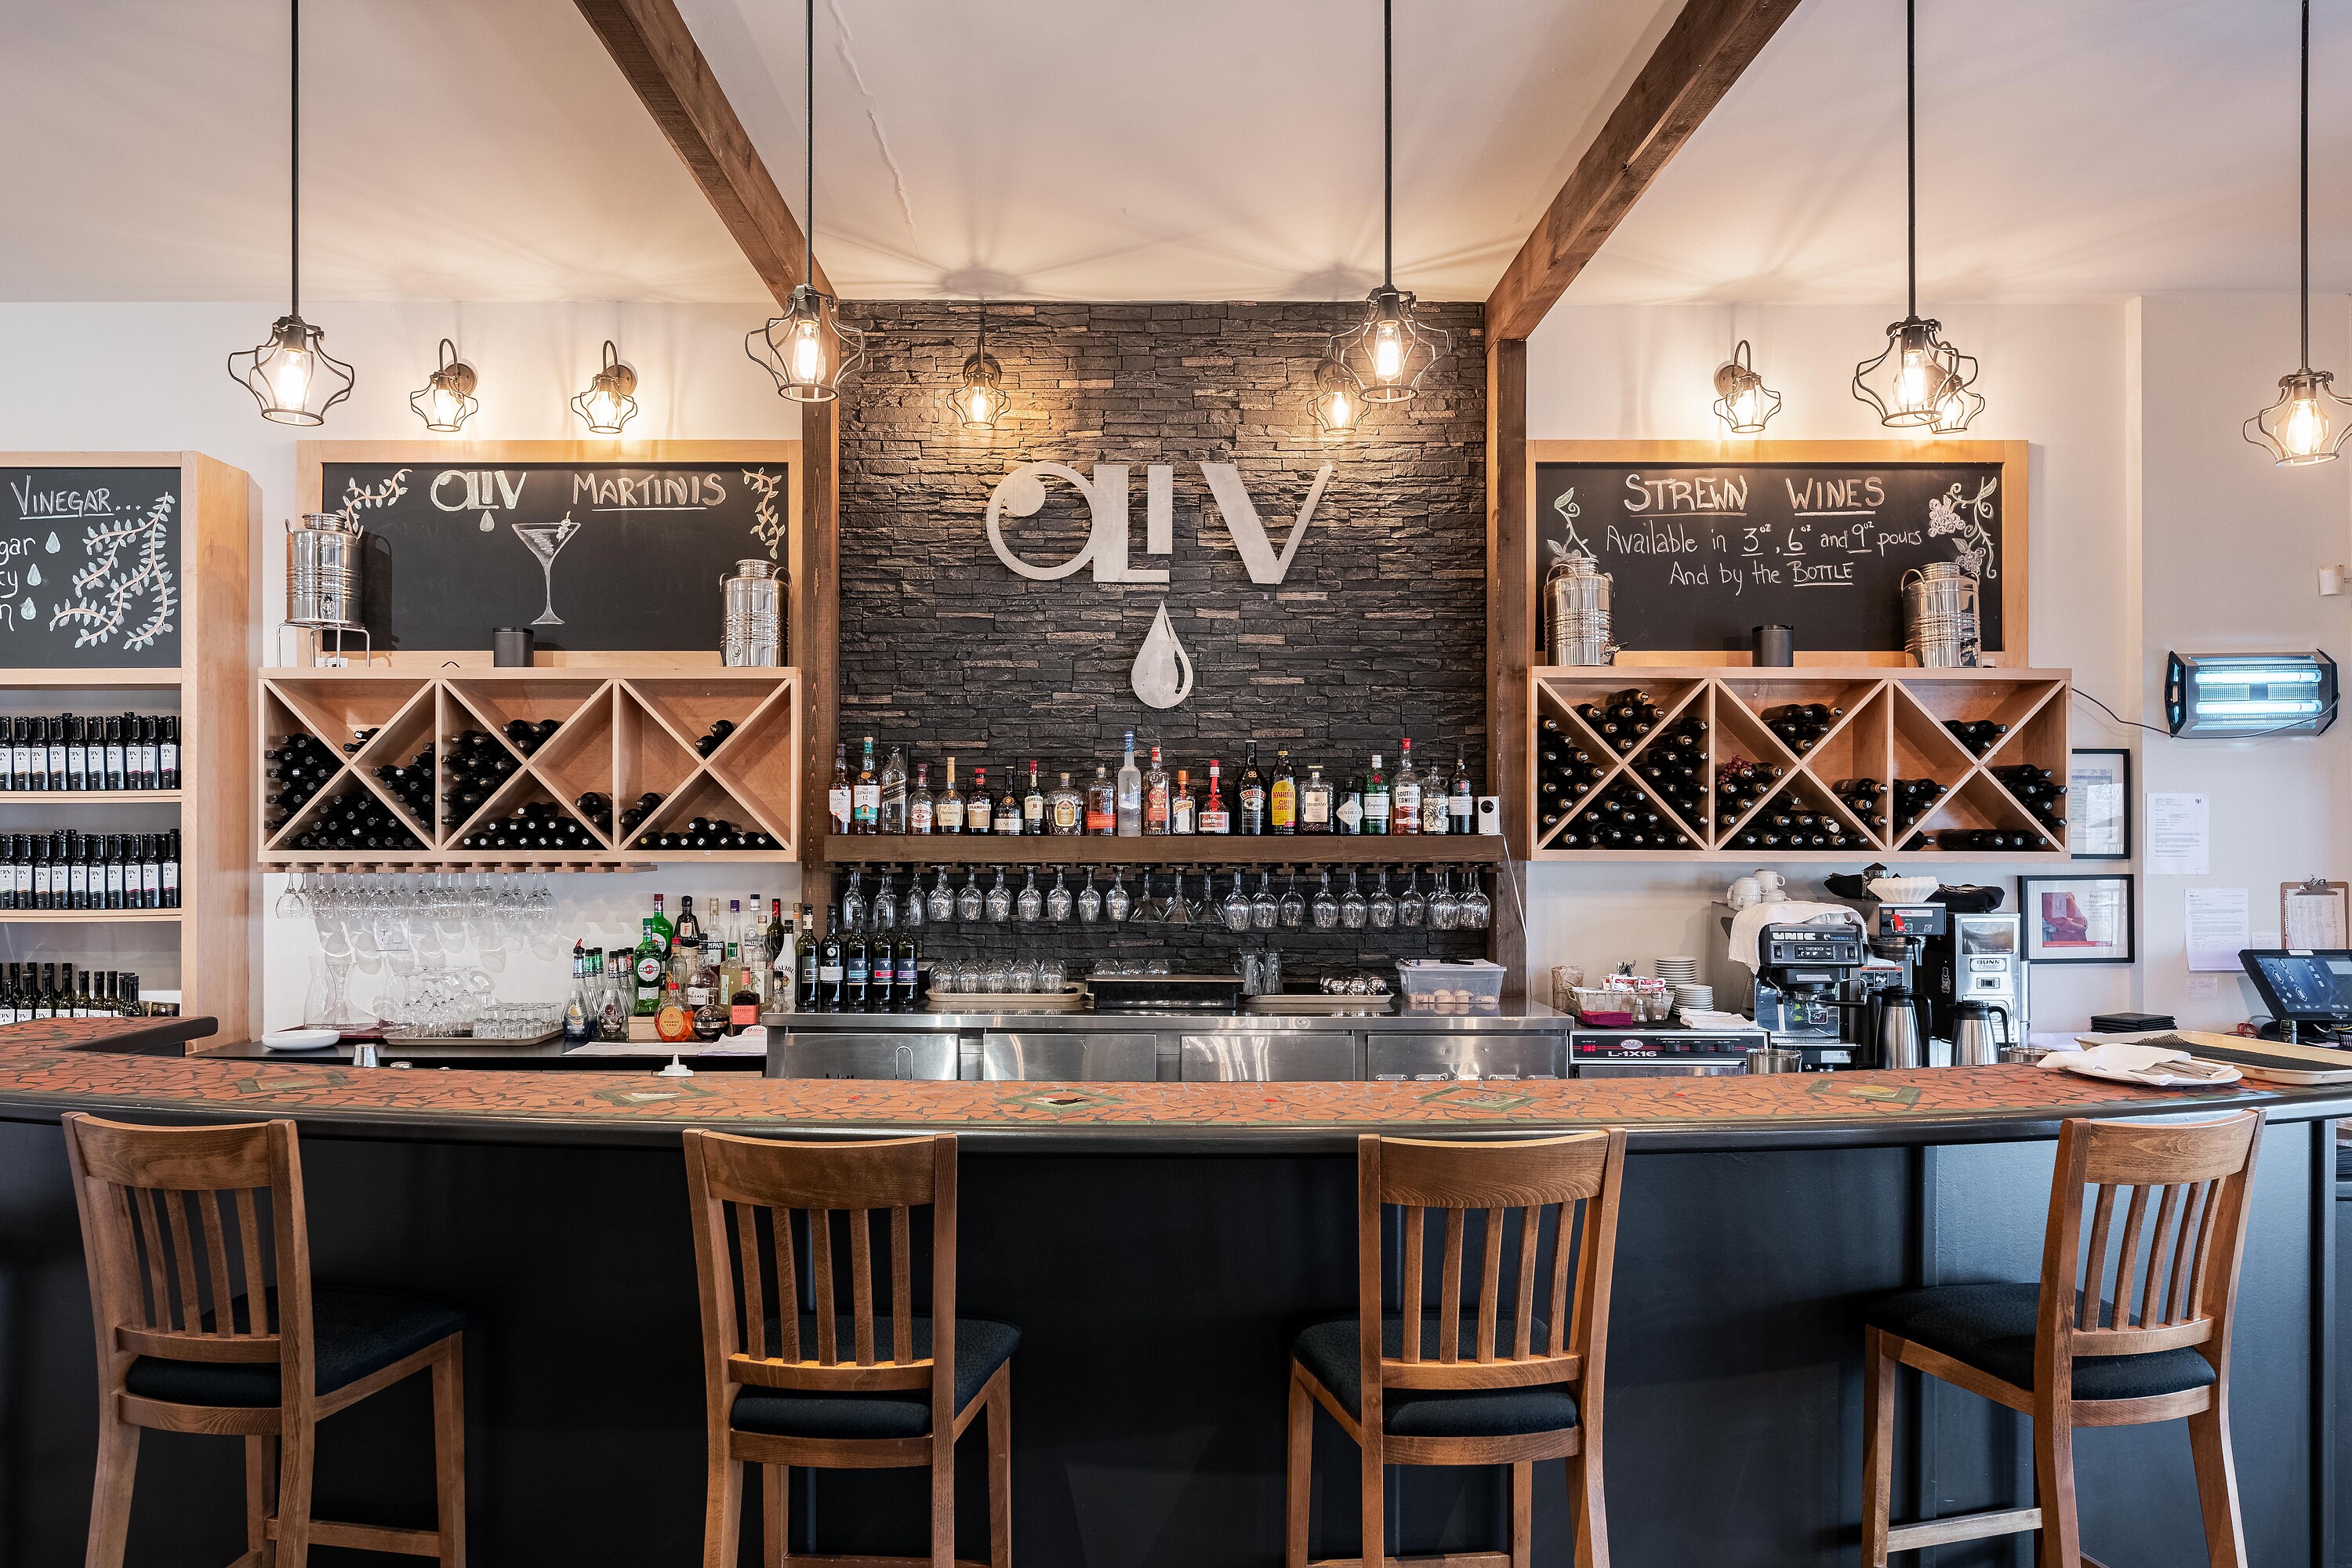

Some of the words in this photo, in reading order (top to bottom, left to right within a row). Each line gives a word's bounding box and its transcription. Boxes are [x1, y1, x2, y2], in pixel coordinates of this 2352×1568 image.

[430, 470, 527, 511] OLIV
[573, 473, 726, 506] MARTINIS
[1624, 474, 1748, 511] STREWN
[1785, 476, 1885, 510] WINES
[986, 461, 1333, 584] OLIV
[1606, 520, 1698, 554] Available
[1711, 528, 1726, 552] in
[1820, 530, 1848, 548] and
[1876, 530, 1922, 557] pours
[1670, 561, 1709, 585] And
[1719, 563, 1742, 596] by
[1752, 560, 1782, 584] the
[1787, 561, 1854, 582] BOTTLE
